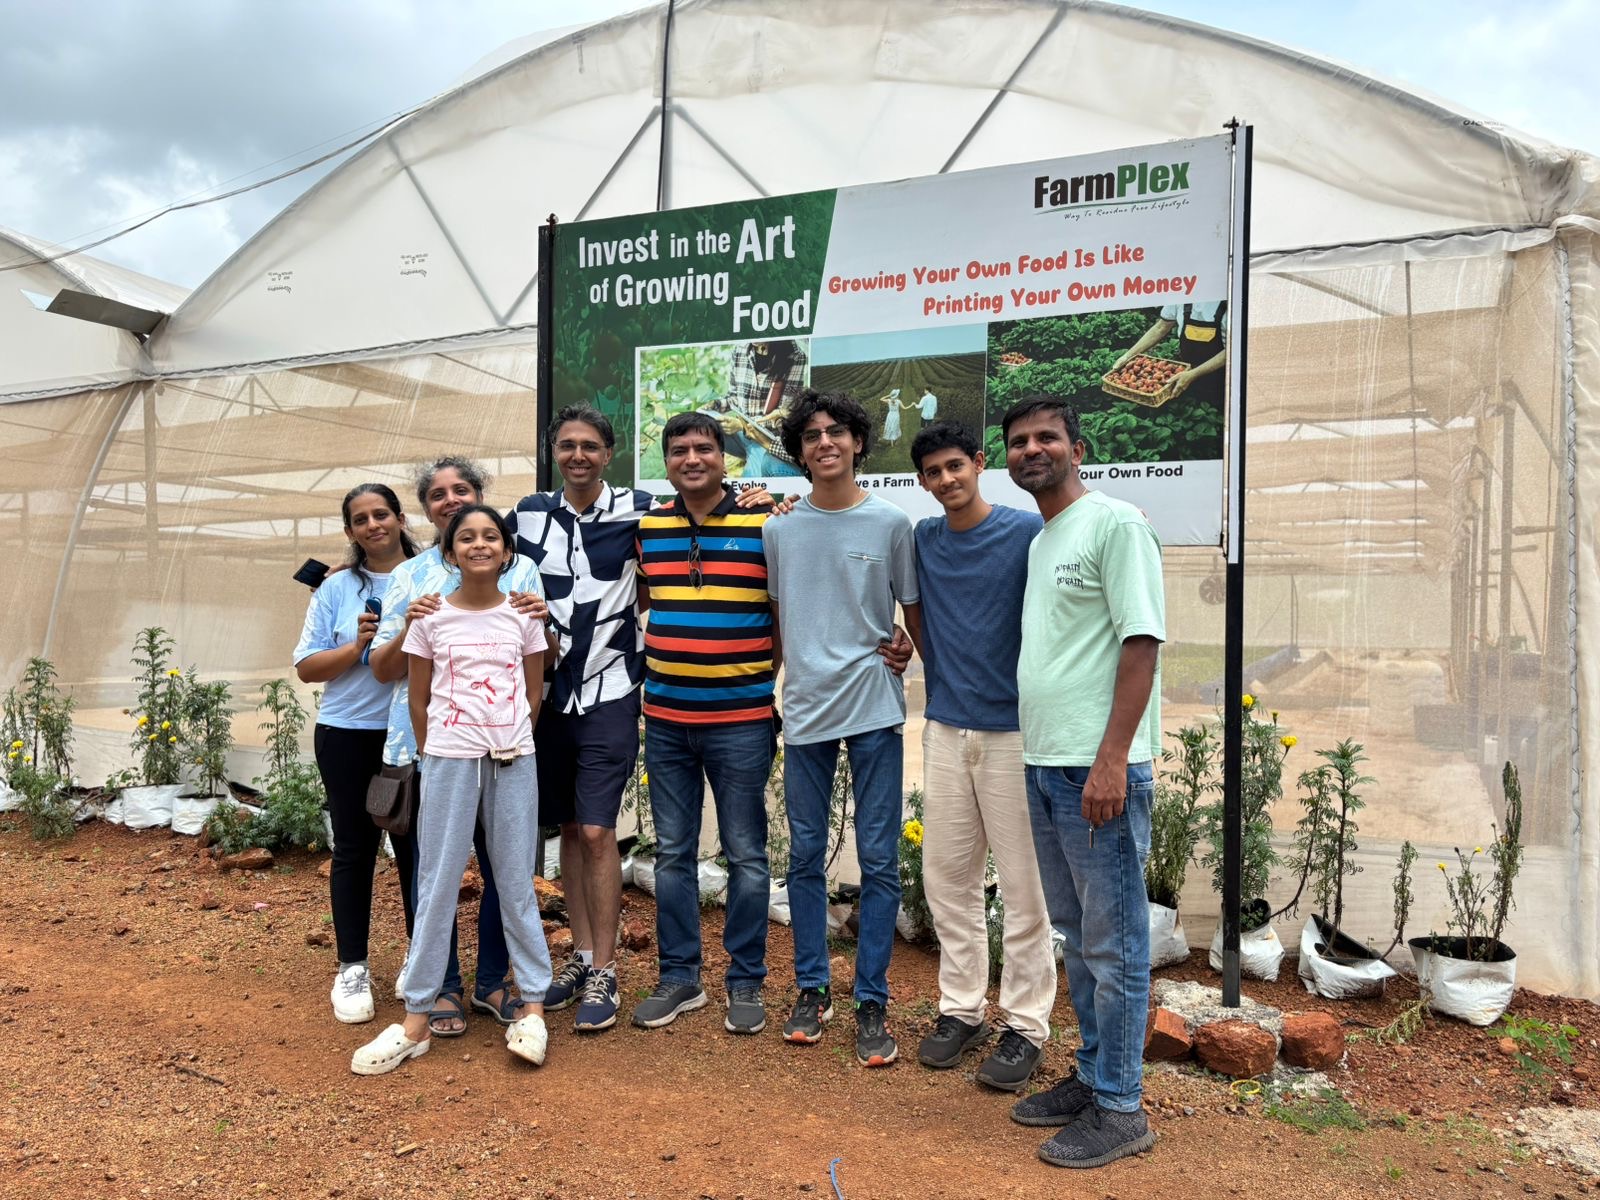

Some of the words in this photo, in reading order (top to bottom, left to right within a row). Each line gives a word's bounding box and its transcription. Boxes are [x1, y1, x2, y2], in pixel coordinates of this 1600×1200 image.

[1034, 161, 1190, 208] FarmPlex
[1064, 213, 1081, 221] Way
[1084, 209, 1092, 217] To
[579, 229, 659, 268] Invest
[670, 233, 689, 259] in
[696, 229, 731, 256] the
[735, 215, 796, 264] Art
[589, 277, 610, 304] of
[615, 268, 729, 308] Growing
[828, 270, 906, 294] Growing
[912, 266, 960, 285] Your
[966, 260, 1011, 279] Own
[1018, 250, 1068, 274] Food
[1074, 248, 1096, 268] Is
[1102, 243, 1145, 265] Like
[732, 289, 811, 333] Food
[923, 292, 1004, 316] Printing
[1010, 287, 1061, 307] Your
[1067, 282, 1116, 302] Own
[1123, 275, 1197, 296] Money
[872, 479, 880, 488] a
[883, 477, 914, 487] Farm
[1077, 468, 1104, 480] our
[1108, 467, 1141, 479] Own
[1146, 464, 1183, 477] Food
